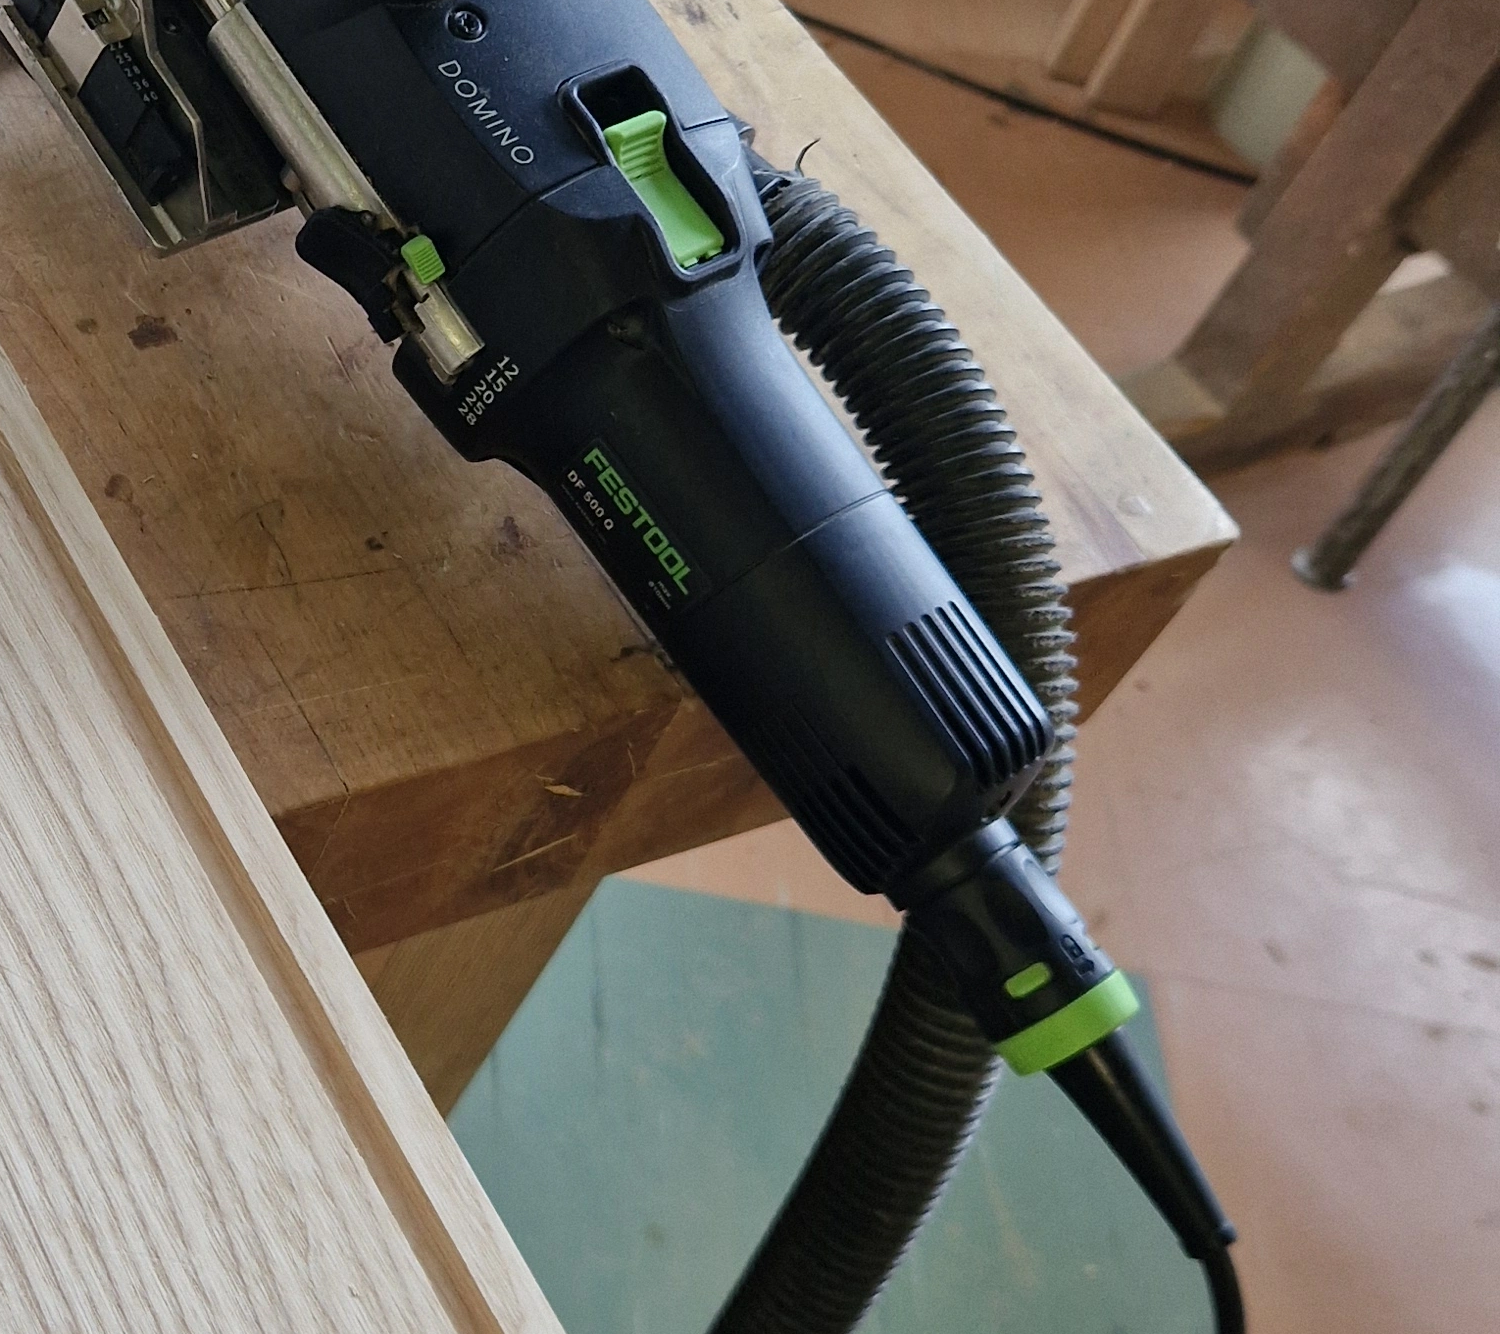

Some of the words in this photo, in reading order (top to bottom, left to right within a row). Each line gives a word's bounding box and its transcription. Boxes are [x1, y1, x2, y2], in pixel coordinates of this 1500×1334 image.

[115, 52, 133, 65] 25
[123, 65, 141, 78] 28
[132, 78, 150, 91] 36
[142, 91, 159, 103] 40
[438, 59, 534, 164] DOMINO
[484, 368, 507, 392] 15
[496, 355, 519, 381] 12
[465, 391, 486, 415] 25
[474, 379, 495, 404] 20
[458, 402, 477, 425] 28
[567, 470, 586, 490] DF
[583, 490, 605, 518] 500
[603, 518, 614, 531] Q
[583, 447, 691, 596] FESTOOL
